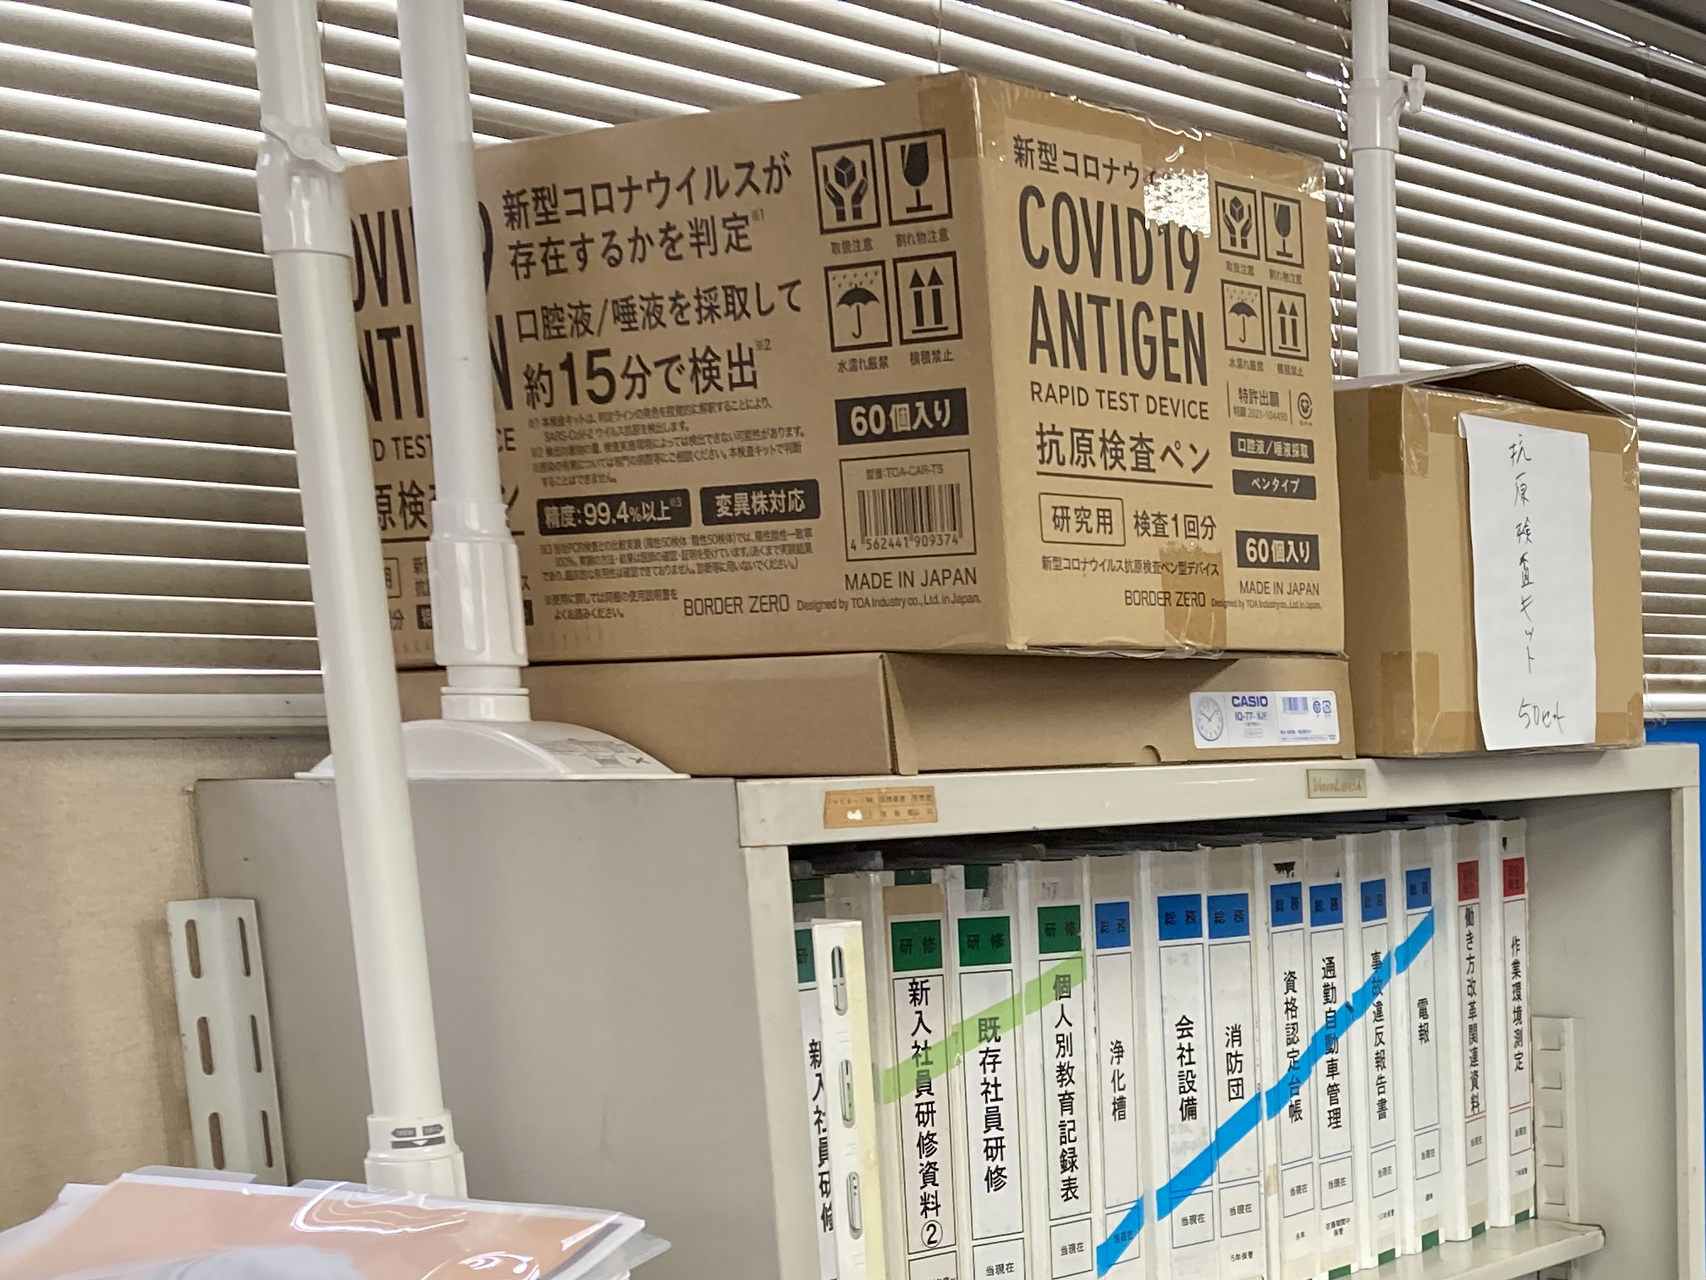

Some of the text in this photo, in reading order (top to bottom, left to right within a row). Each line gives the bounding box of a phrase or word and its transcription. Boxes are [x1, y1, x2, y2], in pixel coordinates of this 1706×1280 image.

[1013, 134, 1160, 190] 新型コロナウ
[502, 151, 793, 231] 新型コロナウイルスが
[508, 212, 753, 281] 存在するかを判定
[895, 228, 950, 247] 割れ物注意
[1019, 185, 1201, 293] COVID19
[1029, 284, 1208, 387] ANTIGEN
[523, 342, 759, 409] 約15分で検出
[850, 399, 951, 436] 60個入り
[1030, 381, 1210, 421] RAPID TEST DEVICE
[1036, 422, 1211, 474] 抗原検査ペン
[714, 488, 806, 518] 変異株対応
[1251, 478, 1301, 493] ペンタイプ
[543, 500, 672, 529] 精度:99.4%以上
[1051, 505, 1217, 540] 研究用 検査1回分
[866, 536, 910, 551] 562441
[913, 533, 959, 548] 909374
[1245, 538, 1311, 563] 60個入り
[1508, 434, 1534, 674] 抗原検査キット
[845, 567, 978, 590] MADE IN JAPAN
[1041, 555, 1220, 576] 新型コロナウイルス抗原検査ペン型デバイス
[683, 593, 790, 617] BORDER ZERO
[797, 598, 838, 613] Designed
[839, 598, 849, 611] by
[852, 597, 871, 609] TOA
[1124, 589, 1206, 608] BORDER ZERO
[1239, 581, 1320, 596] MADE IN JAPAN
[1231, 696, 1268, 708] CASIO
[965, 931, 1005, 951] 研修
[1416, 997, 1431, 1046] 電報
[1463, 905, 1481, 1116] 働き方改革関連資料
[1510, 935, 1526, 1072] 作業環境測定
[1283, 970, 1304, 1125] 資格認定台帳
[1321, 956, 1344, 1131] 通勤自動車管理
[1371, 950, 1390, 1121] 事故違反報告書
[1109, 1038, 1127, 1123] 浄化槽
[1174, 1014, 1199, 1123] 会社設備
[1224, 1022, 1246, 1103] 消防団
[977, 1015, 1009, 1194] 既存社員研修
[1052, 973, 1080, 1202] 個人別教育記録表
[907, 979, 944, 1249] 新入社員研修資料②
[1181, 1213, 1206, 1227] 当現在
[1229, 1203, 1254, 1217] 当現在
[1060, 1241, 1085, 1257] 当現在
[986, 1261, 1016, 1278] 当現在
